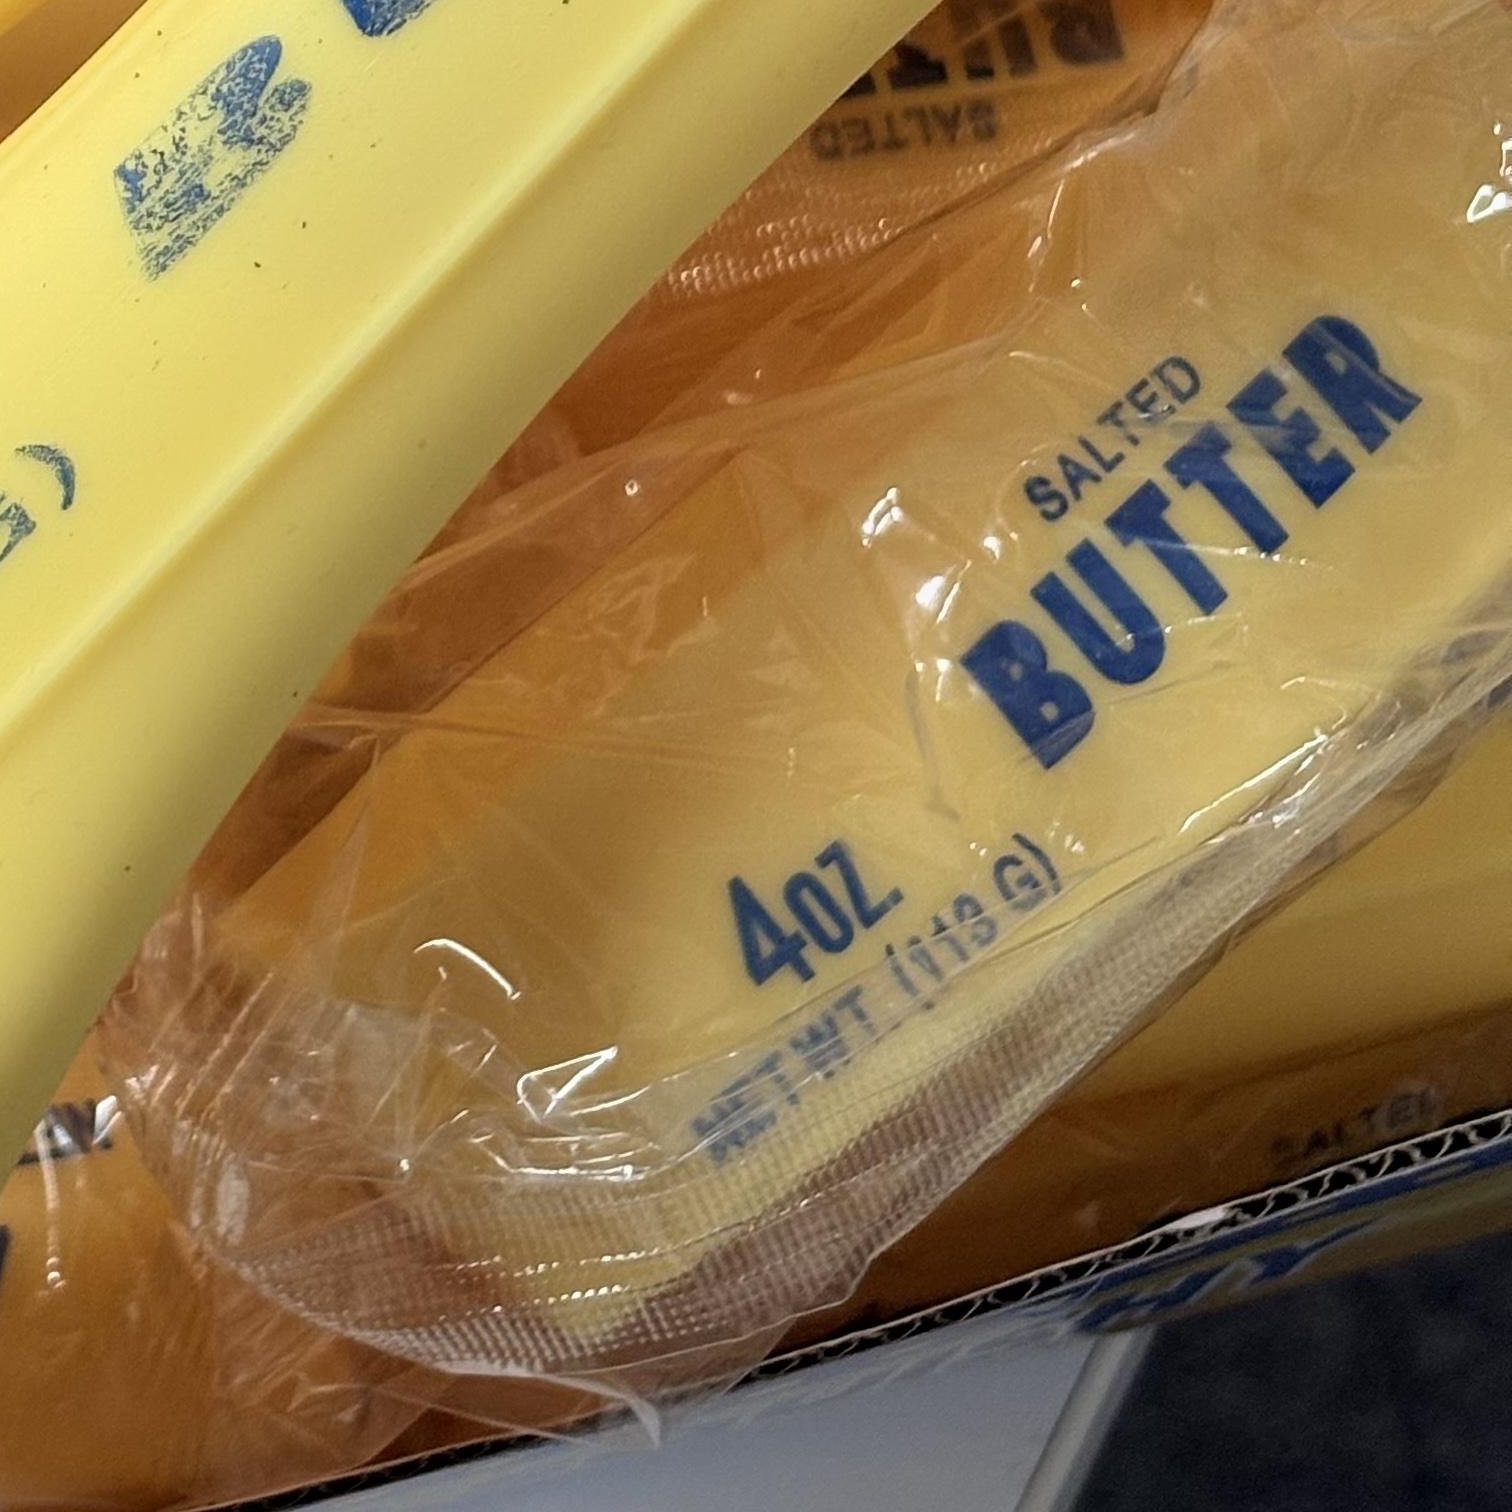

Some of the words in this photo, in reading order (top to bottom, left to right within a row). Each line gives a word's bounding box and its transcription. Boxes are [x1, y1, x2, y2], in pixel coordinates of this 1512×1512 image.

[809, 97, 998, 161] SALTED
[1023, 355, 1203, 522] SALTED
[960, 314, 1424, 770] BUTTER
[992, 832, 1062, 914] G)
